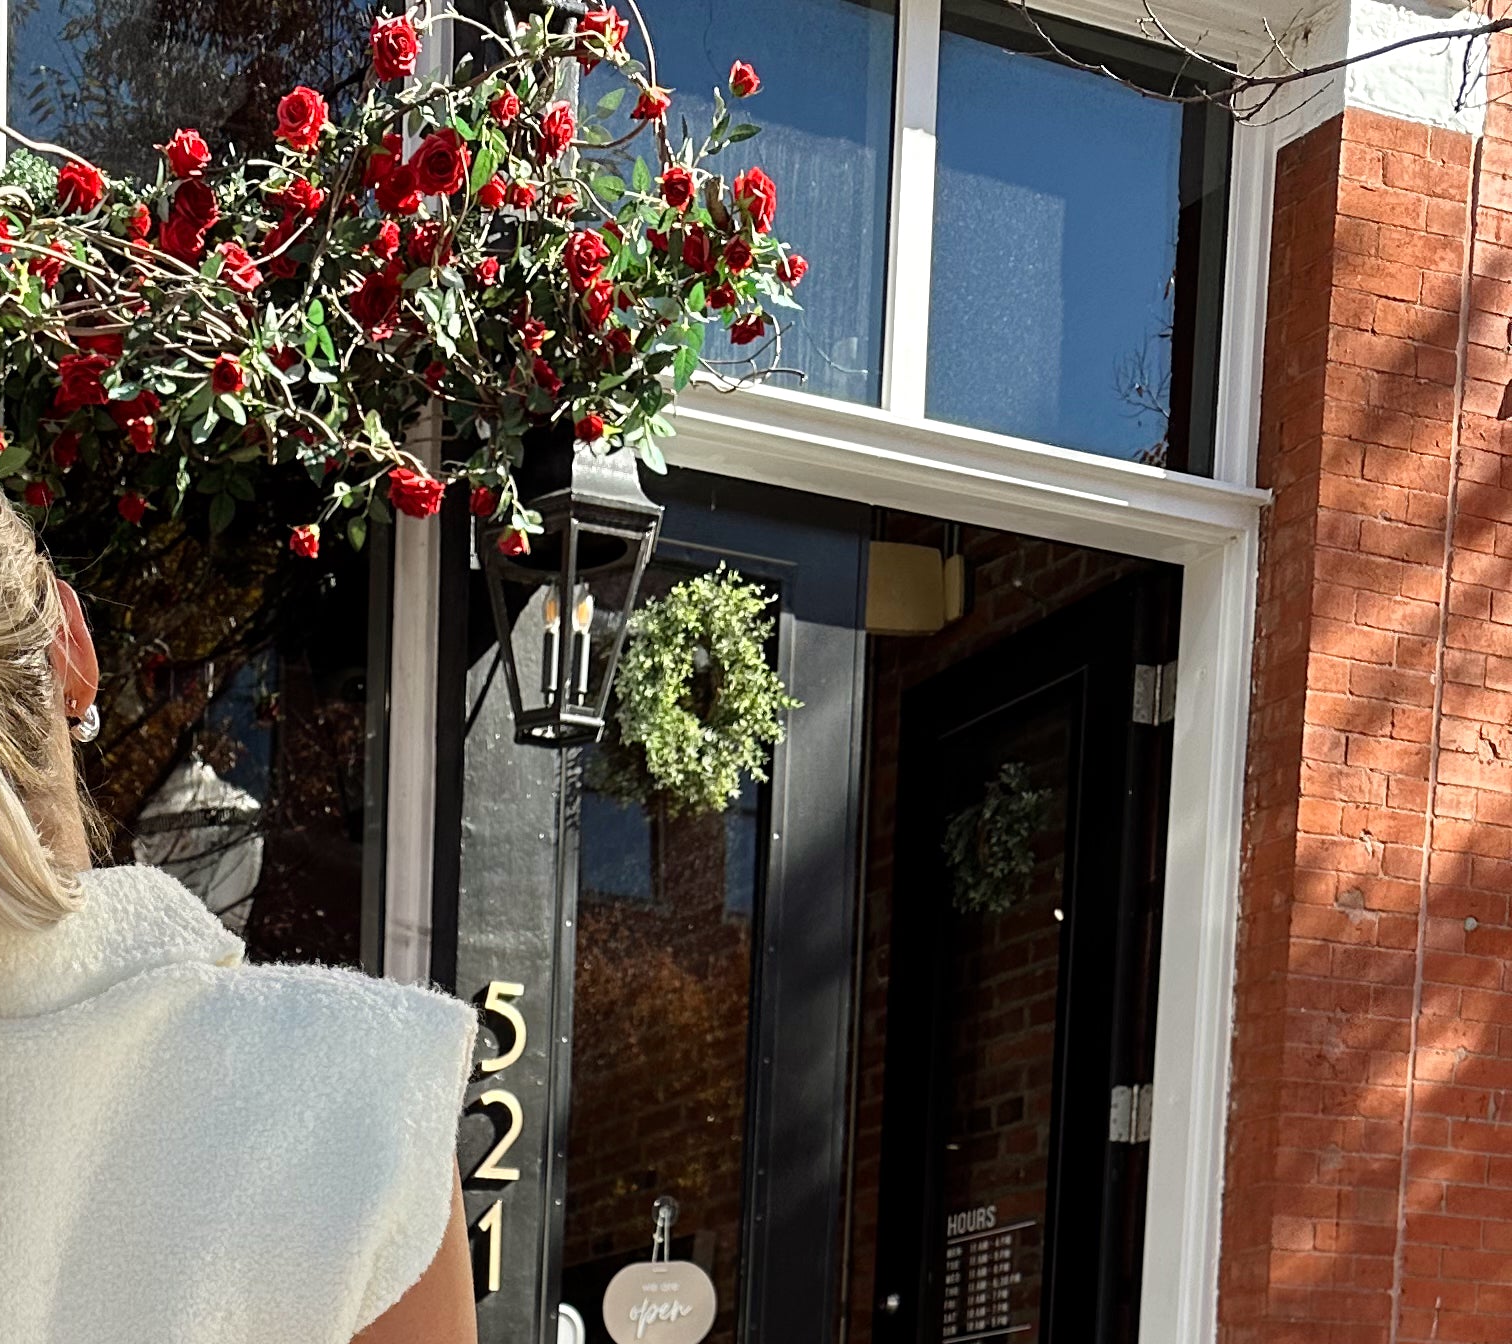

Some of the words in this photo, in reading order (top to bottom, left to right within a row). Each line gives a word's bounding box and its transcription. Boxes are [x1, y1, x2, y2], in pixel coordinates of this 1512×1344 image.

[473, 980, 527, 1292] 521
[946, 1204, 997, 1238] HOURS
[629, 1295, 693, 1340] open
